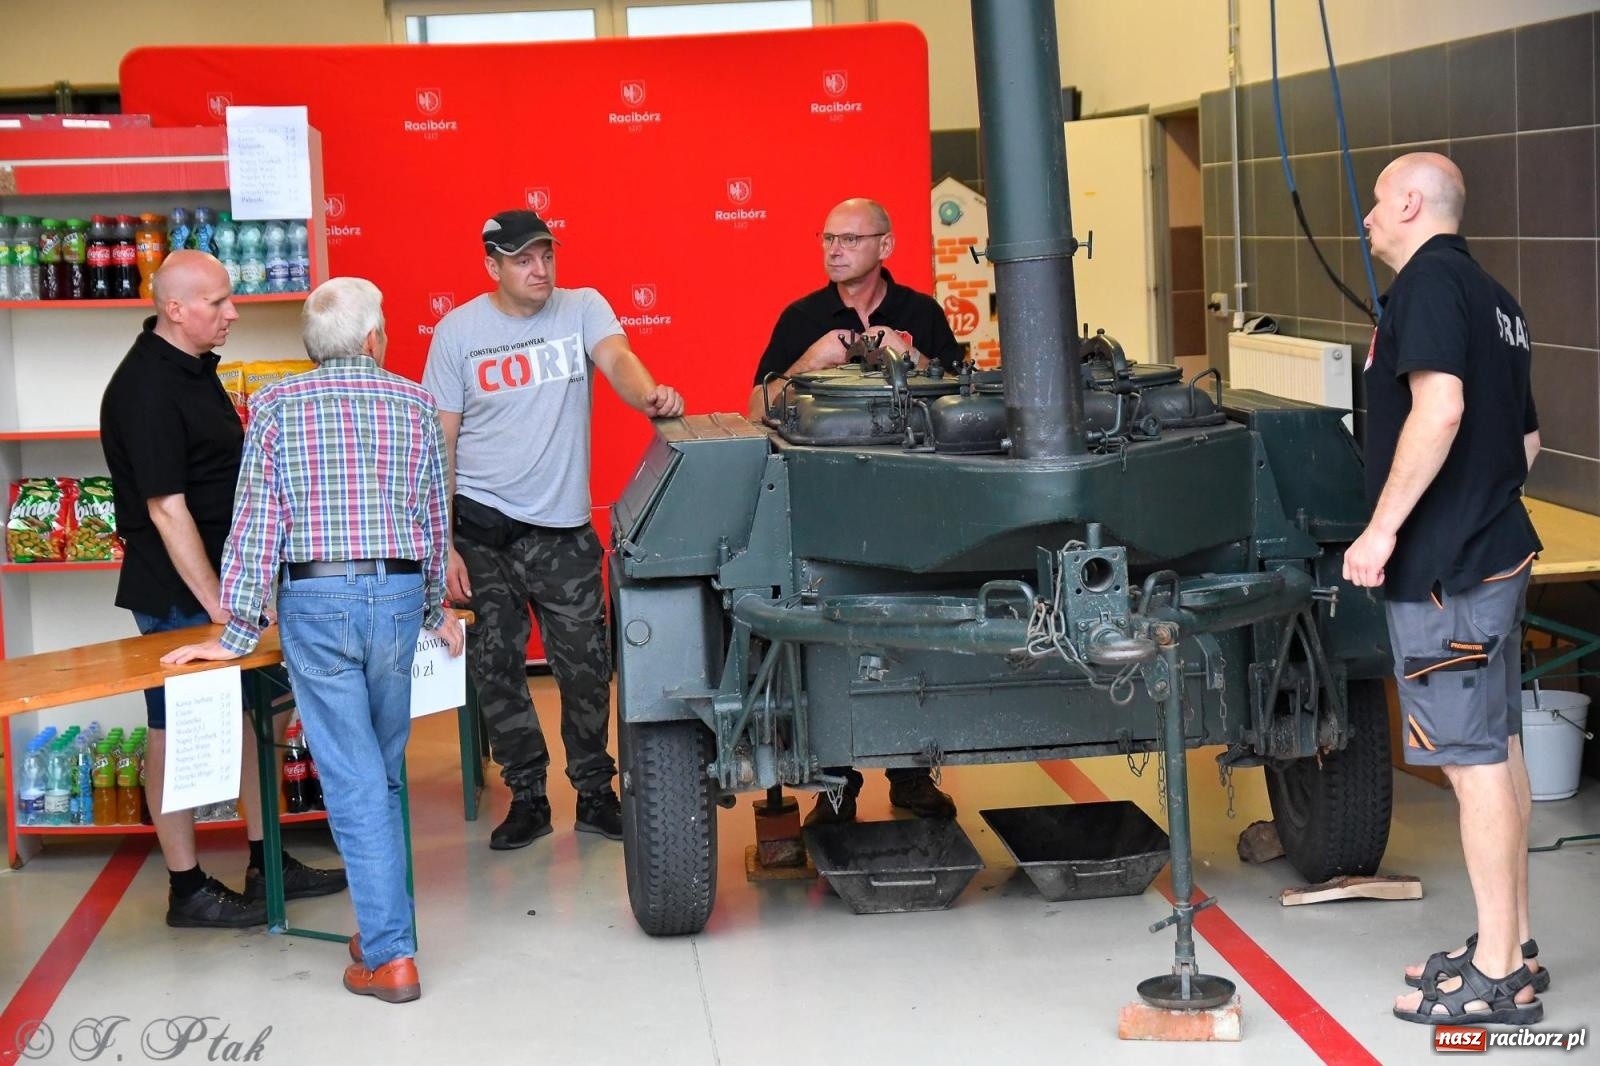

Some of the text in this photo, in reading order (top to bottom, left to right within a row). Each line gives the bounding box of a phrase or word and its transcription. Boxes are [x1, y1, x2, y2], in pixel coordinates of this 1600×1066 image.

[810, 101, 863, 113] Racibórz
[608, 111, 662, 123] Racibórz
[404, 119, 457, 131] Racibórz
[715, 208, 767, 221] Racibórz
[620, 315, 671, 326] Racibórz
[947, 313, 975, 332] 112
[469, 337, 545, 358] CONSTRUCTED WORKWEAR
[477, 336, 582, 392] CORE
